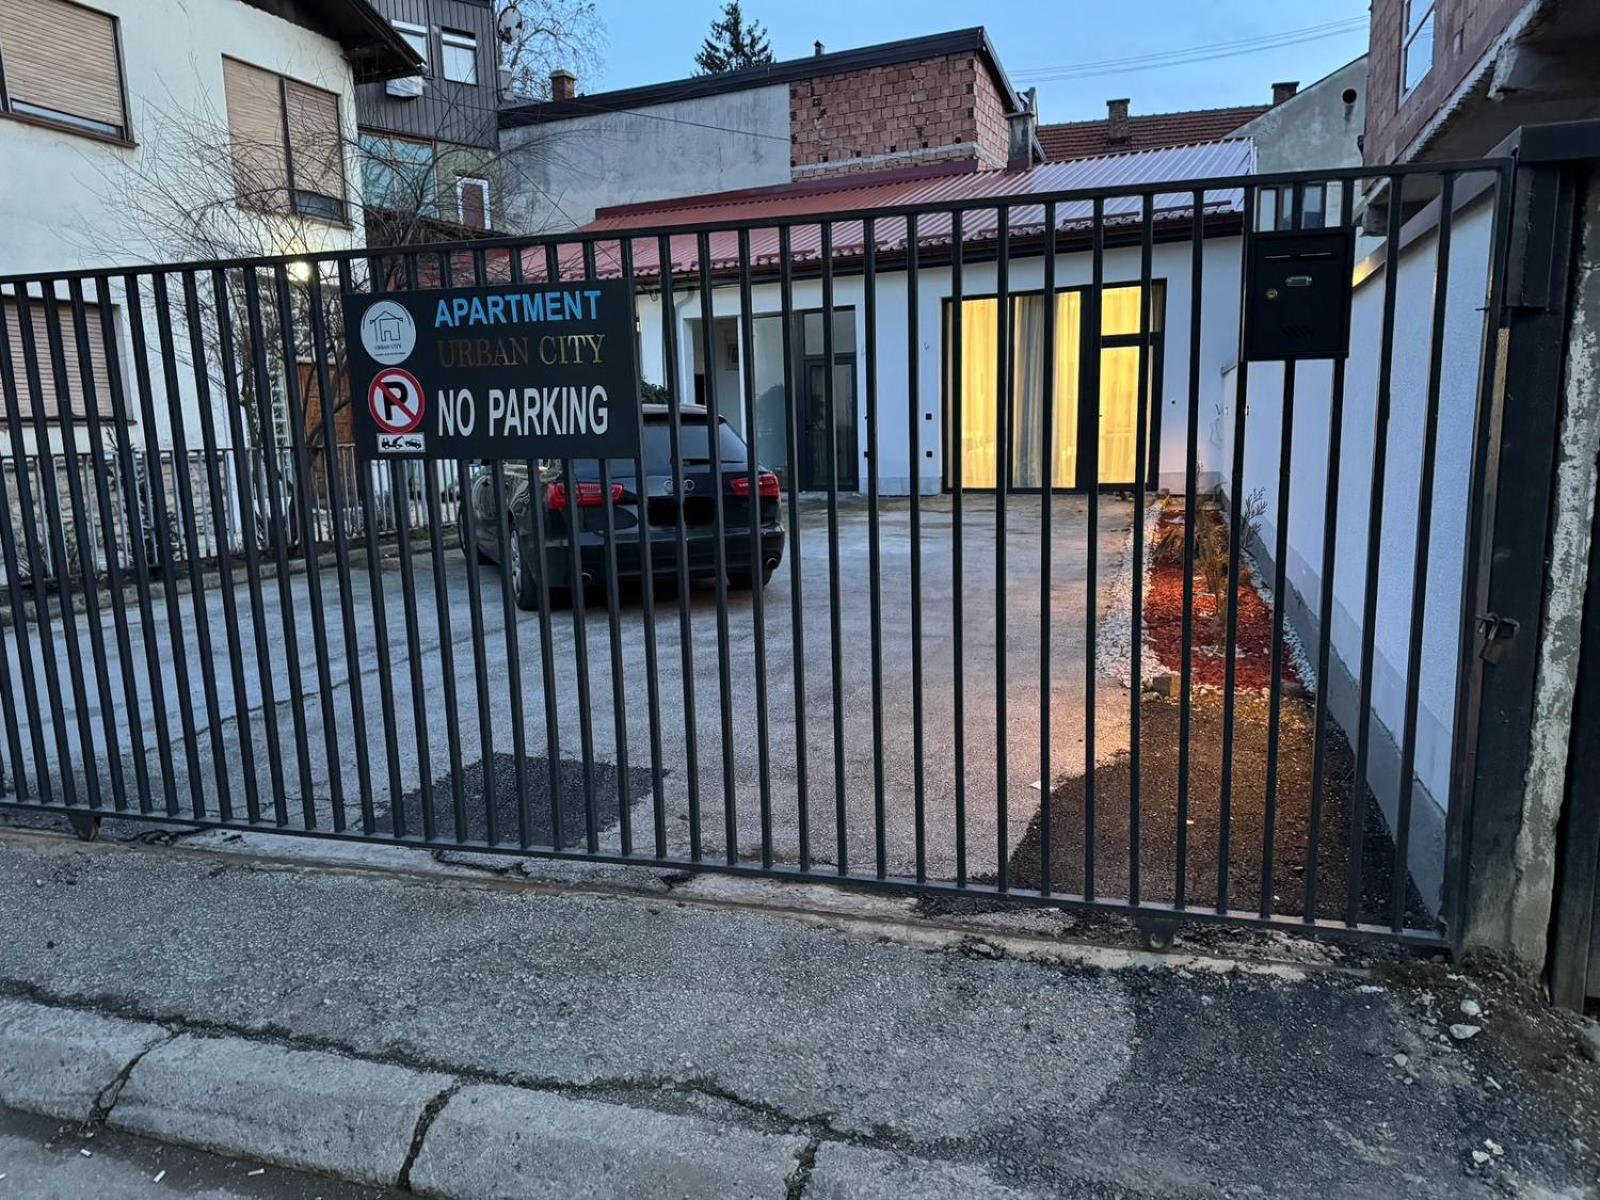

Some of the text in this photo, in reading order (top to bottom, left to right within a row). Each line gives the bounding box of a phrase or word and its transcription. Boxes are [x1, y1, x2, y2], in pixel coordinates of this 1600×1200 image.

[435, 290, 601, 328] APARTMENT
[437, 334, 606, 368] URBAN CITY
[382, 381, 408, 421] P
[438, 385, 608, 437] NO PARKING
